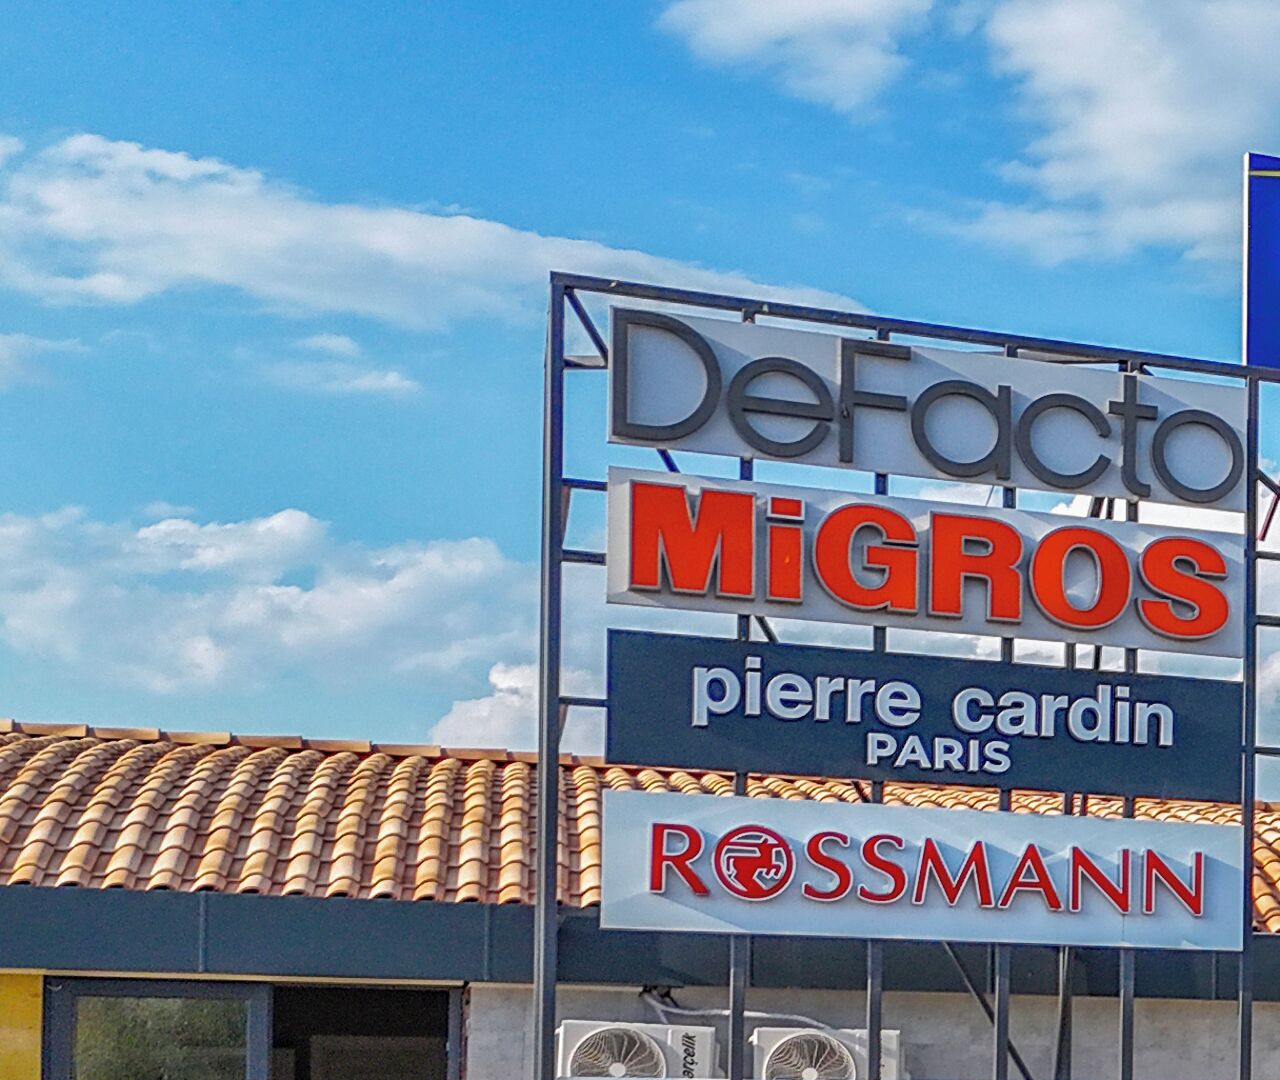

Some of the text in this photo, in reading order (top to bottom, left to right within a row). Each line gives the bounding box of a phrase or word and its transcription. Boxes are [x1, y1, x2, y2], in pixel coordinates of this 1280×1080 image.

[608, 306, 1245, 502] DeFacto
[628, 479, 1230, 640] MiGROS
[691, 657, 1174, 747] pierre cardin
[866, 733, 1012, 773] PARIS
[648, 821, 1204, 917] ROSSMANN
[682, 1032, 698, 1079] arçelik
